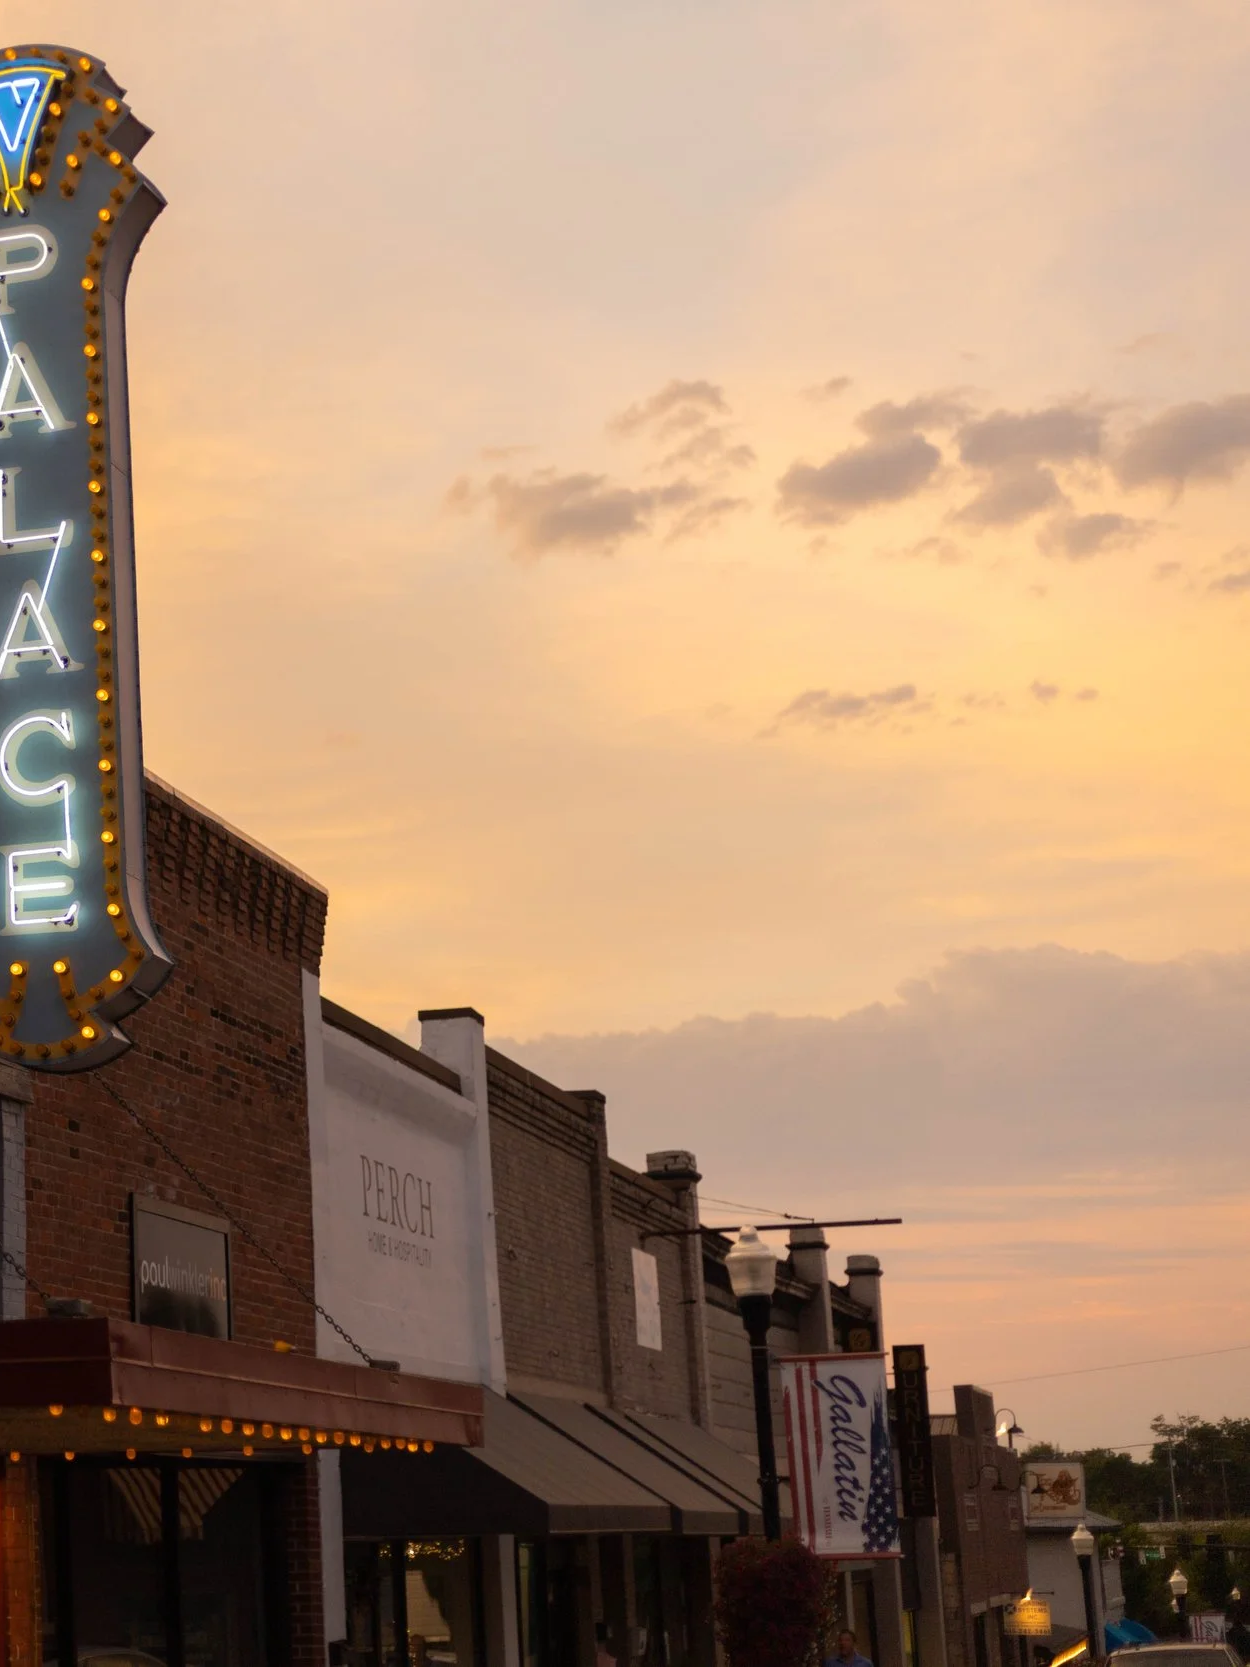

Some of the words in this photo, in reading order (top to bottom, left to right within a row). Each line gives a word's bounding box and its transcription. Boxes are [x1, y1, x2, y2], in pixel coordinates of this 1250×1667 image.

[359, 1153, 435, 1240] PERCH
[367, 1229, 388, 1257] HOME
[813, 1374, 868, 1522] Gallatin
